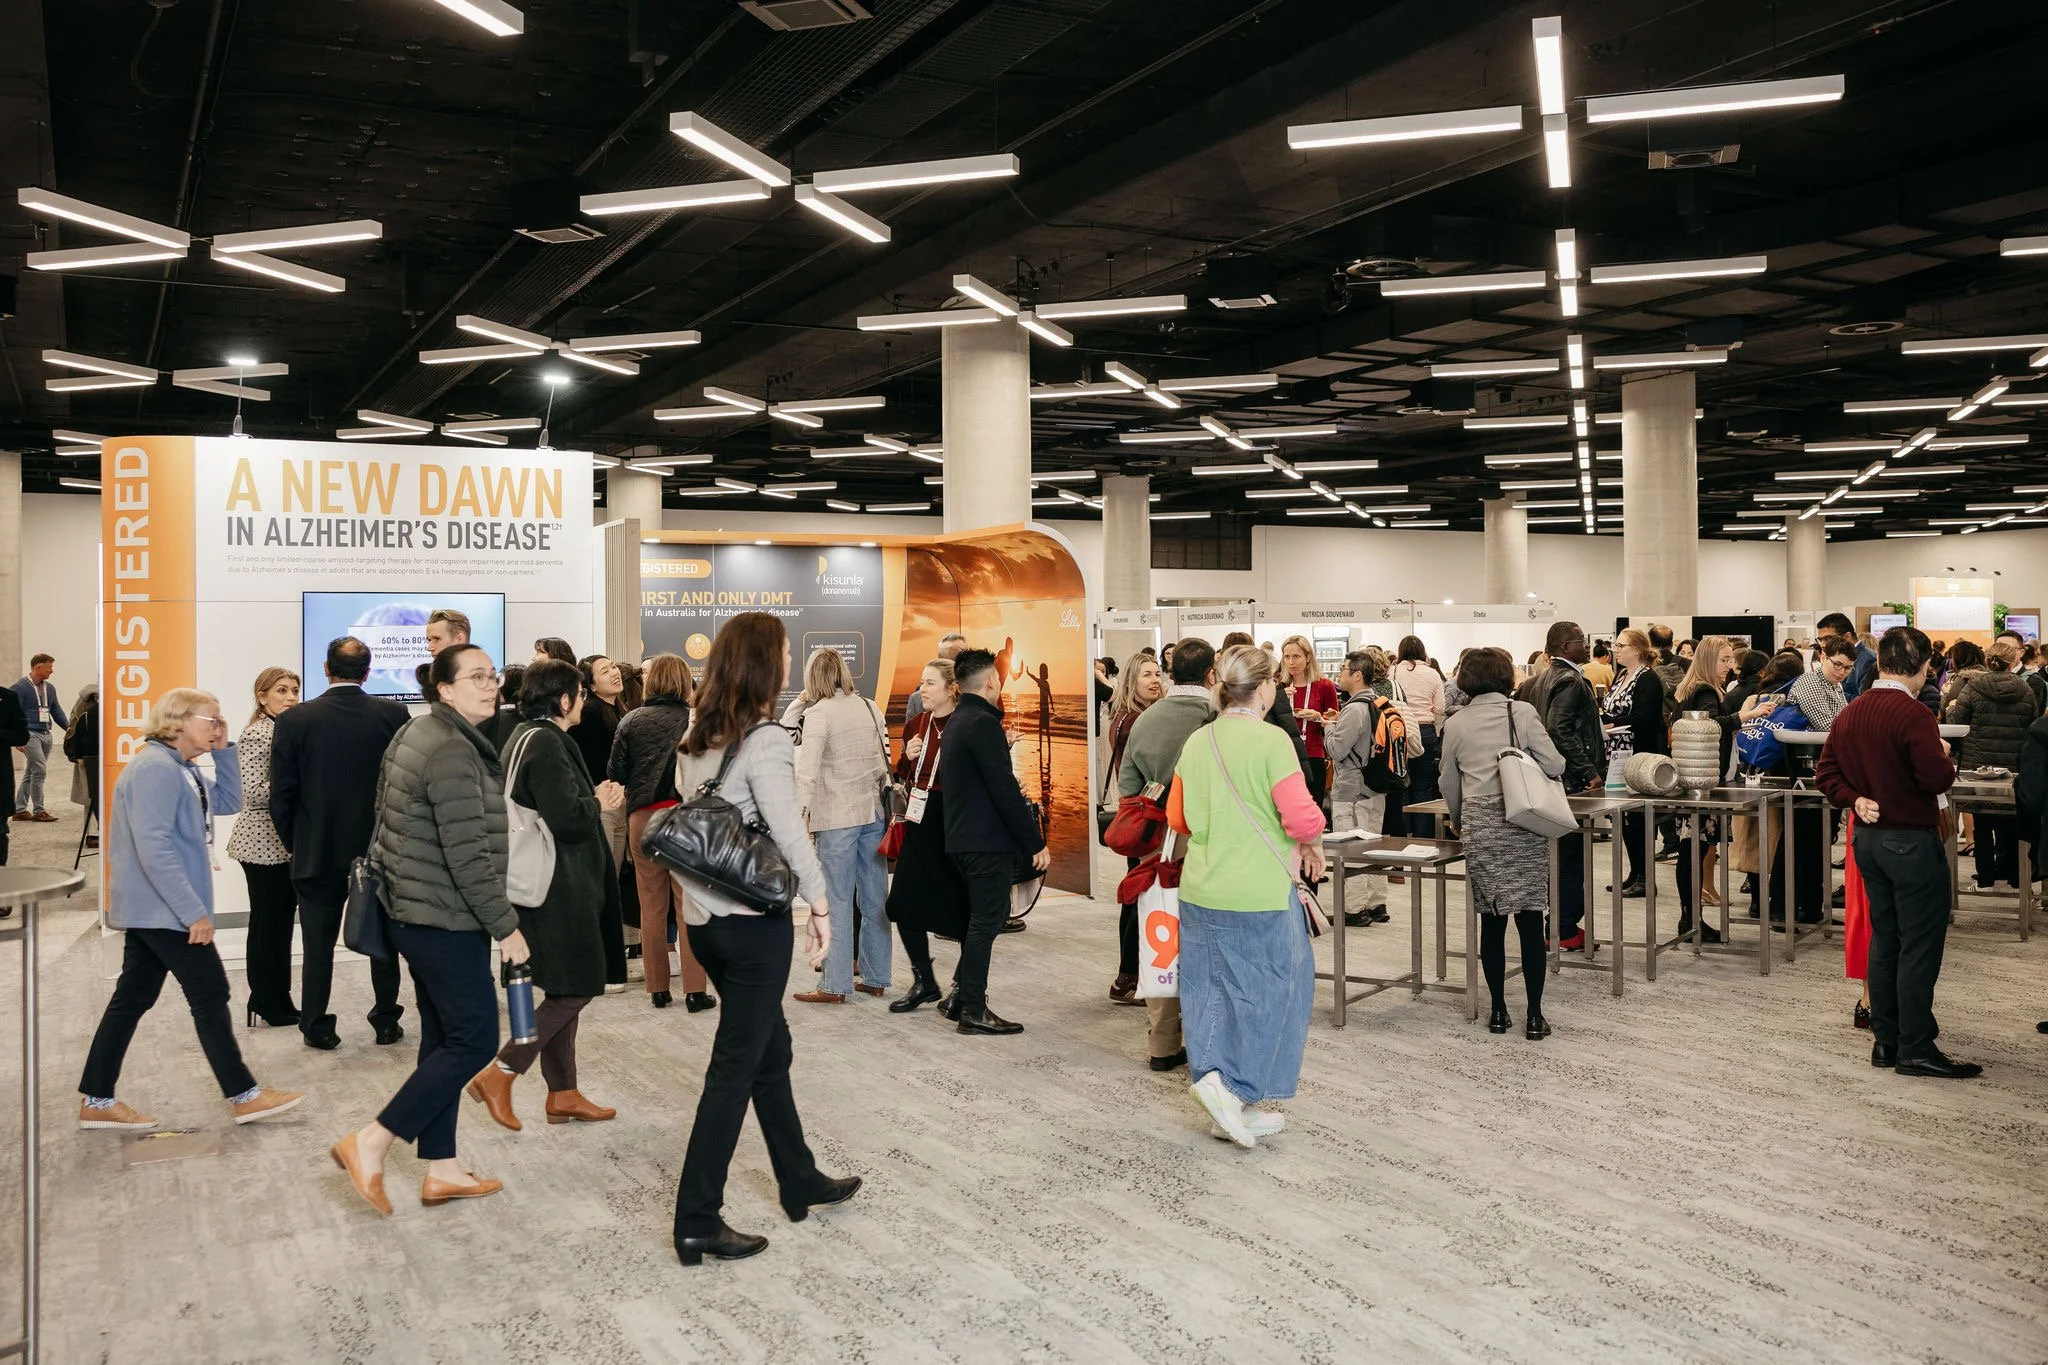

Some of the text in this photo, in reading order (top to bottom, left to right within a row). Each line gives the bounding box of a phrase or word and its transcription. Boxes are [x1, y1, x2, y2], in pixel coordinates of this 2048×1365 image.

[226, 458, 563, 518] A NEW DAWN
[227, 516, 254, 546] IN
[263, 517, 438, 549] ALZHEIMER'S
[261, 556, 274, 564] only
[327, 556, 386, 565] amyloid-targeting
[387, 557, 412, 566] therapy
[440, 559, 468, 567] cognitive
[469, 559, 506, 567] impairment
[441, 568, 485, 576] heterozygotes
[641, 591, 794, 605] IRST AND ONLY DMT
[115, 447, 150, 763] REGISTERED
[645, 608, 653, 617] in
[656, 608, 696, 617] Australia
[699, 608, 712, 617] for
[1741, 728, 1764, 740] agic
[1157, 972, 1174, 985] of
